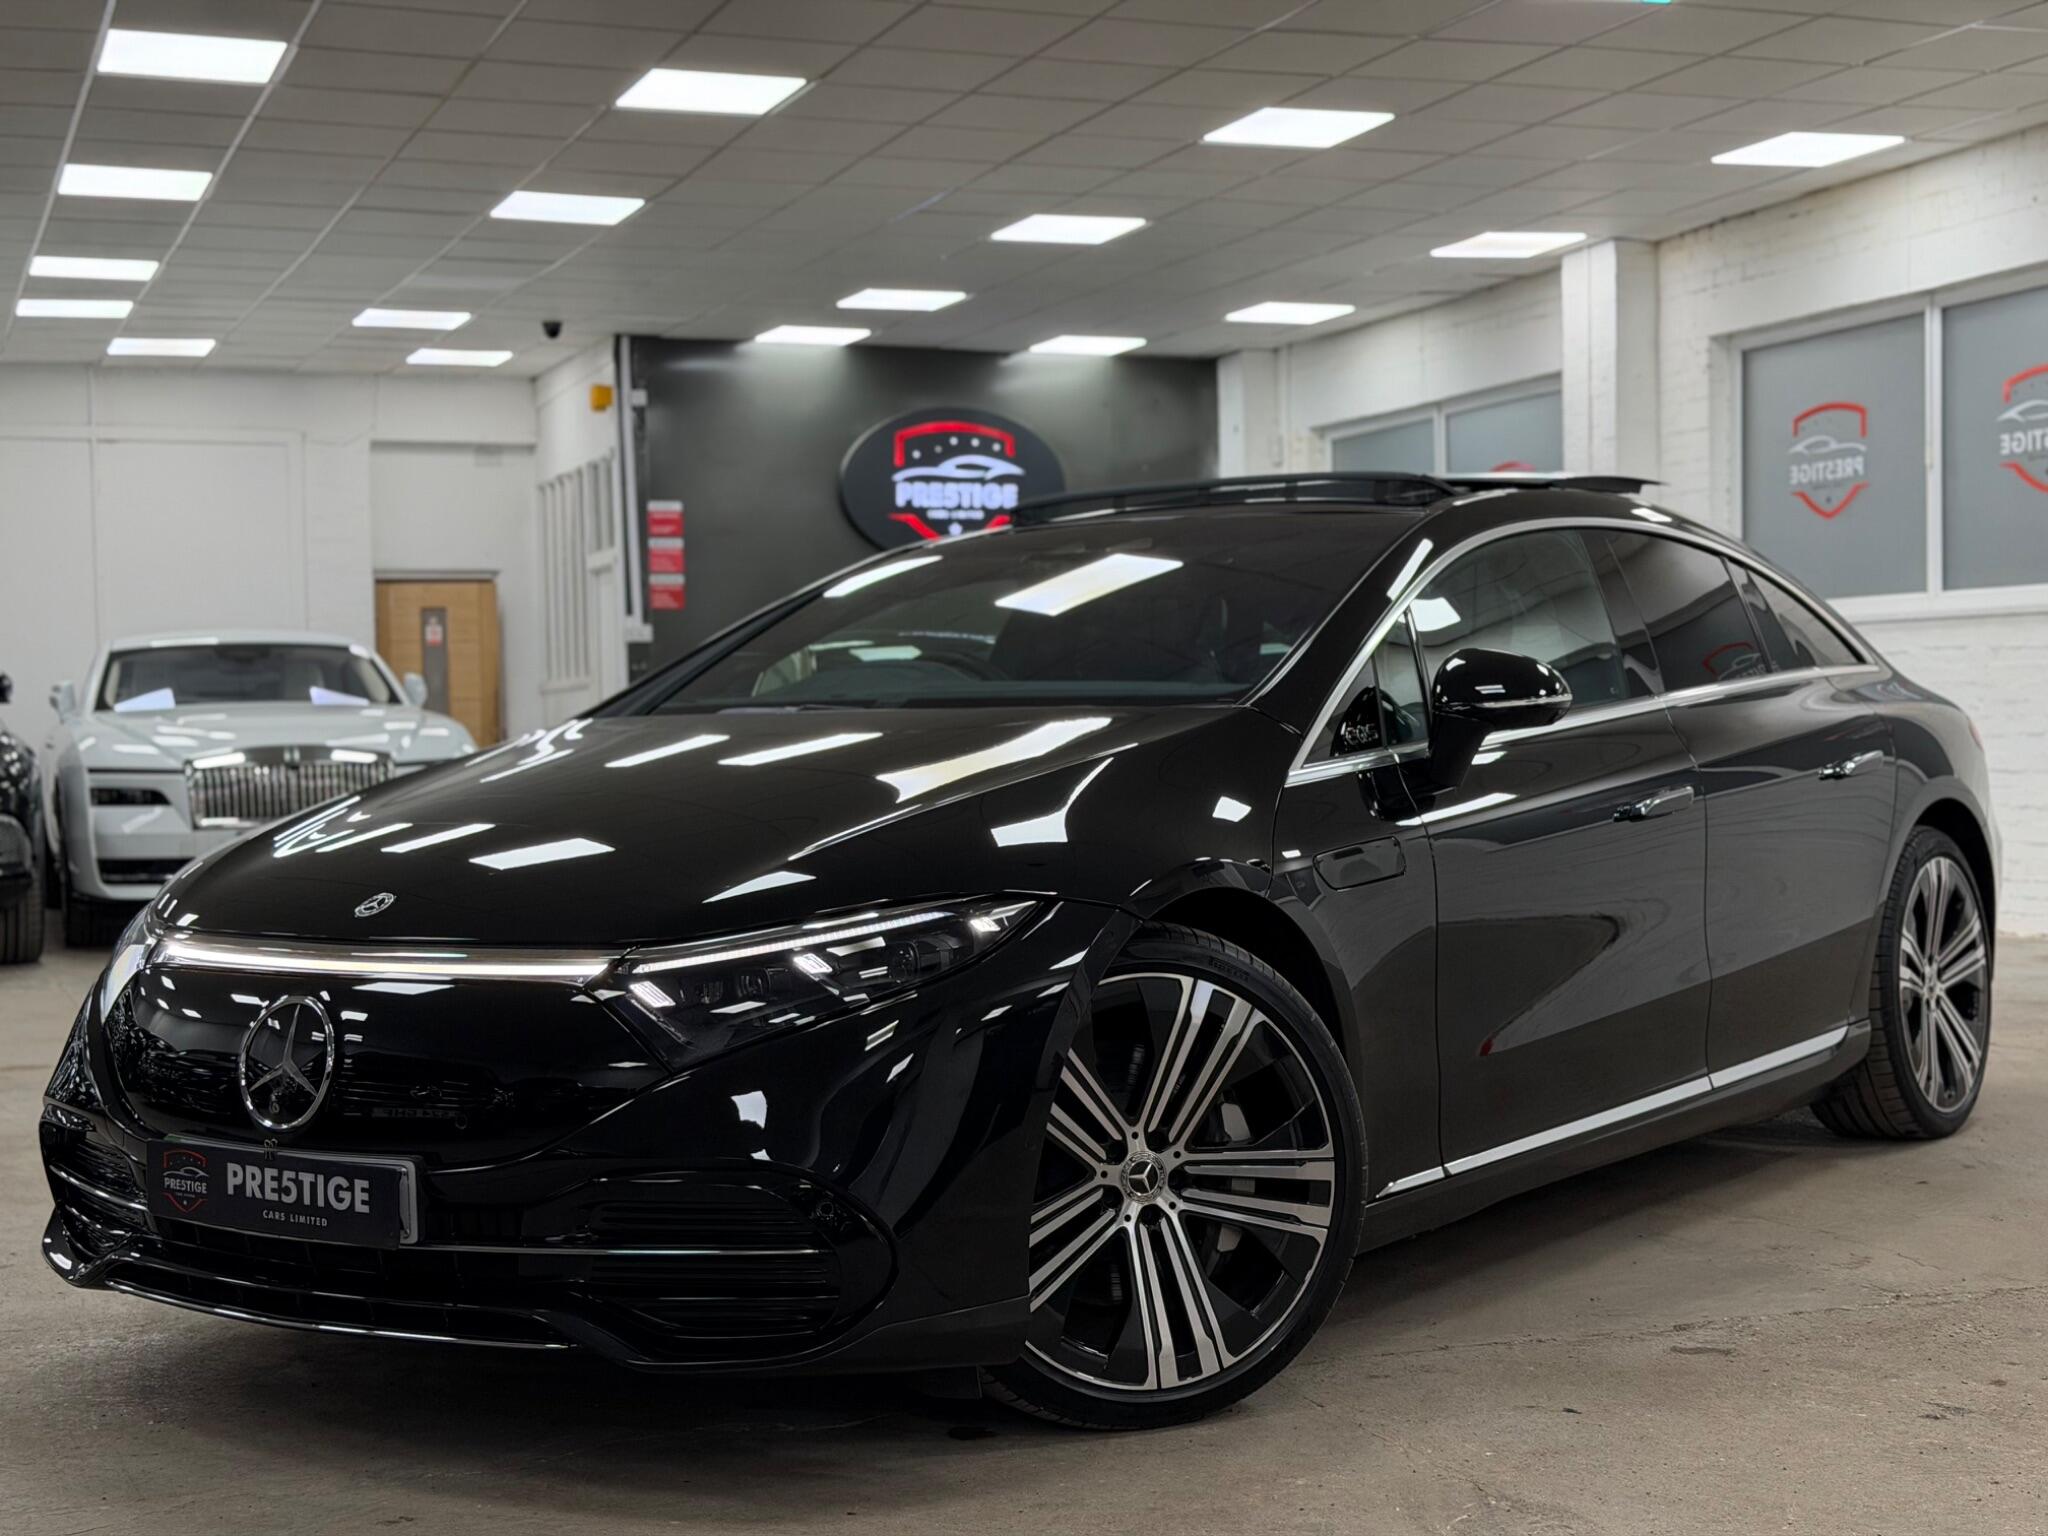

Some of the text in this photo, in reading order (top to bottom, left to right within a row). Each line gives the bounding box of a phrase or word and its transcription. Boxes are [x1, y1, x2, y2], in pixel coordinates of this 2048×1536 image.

[895, 481, 1018, 509] PRESTIGE
[262, 1209, 328, 1227] CARS LIMITED
